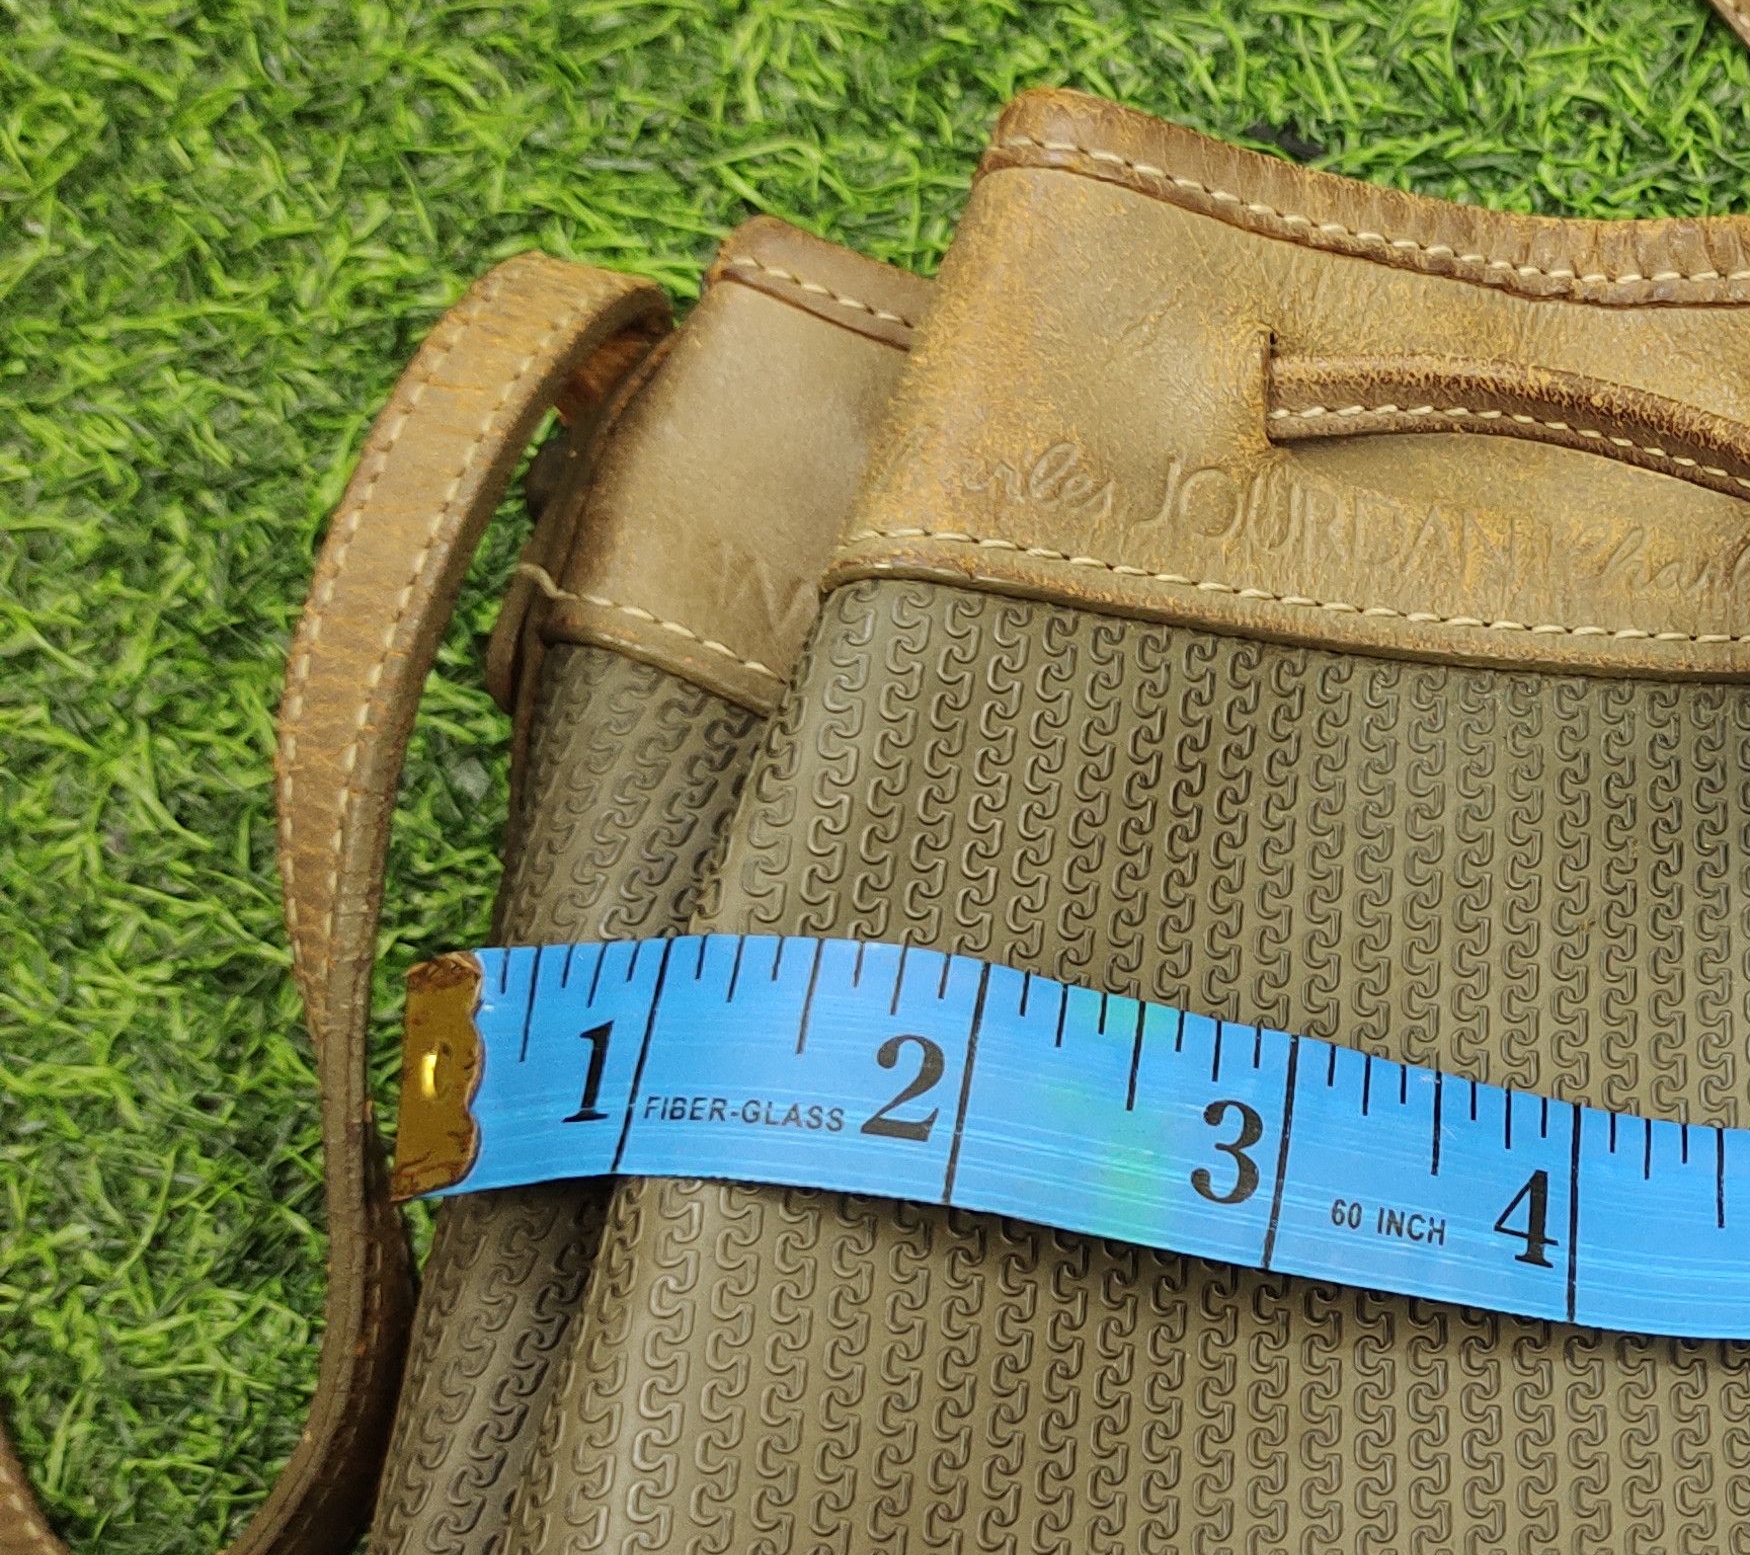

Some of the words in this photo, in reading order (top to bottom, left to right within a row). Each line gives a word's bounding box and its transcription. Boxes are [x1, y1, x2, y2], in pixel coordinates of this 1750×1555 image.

[561, 1020, 615, 1123] 1
[643, 1094, 846, 1132] FIBER-GLASS
[859, 1033, 947, 1143] 2
[1189, 1099, 1264, 1205] 3
[1330, 1198, 1364, 1232] 60
[1376, 1206, 1447, 1247] INCH
[1492, 1169, 1559, 1269] 4
